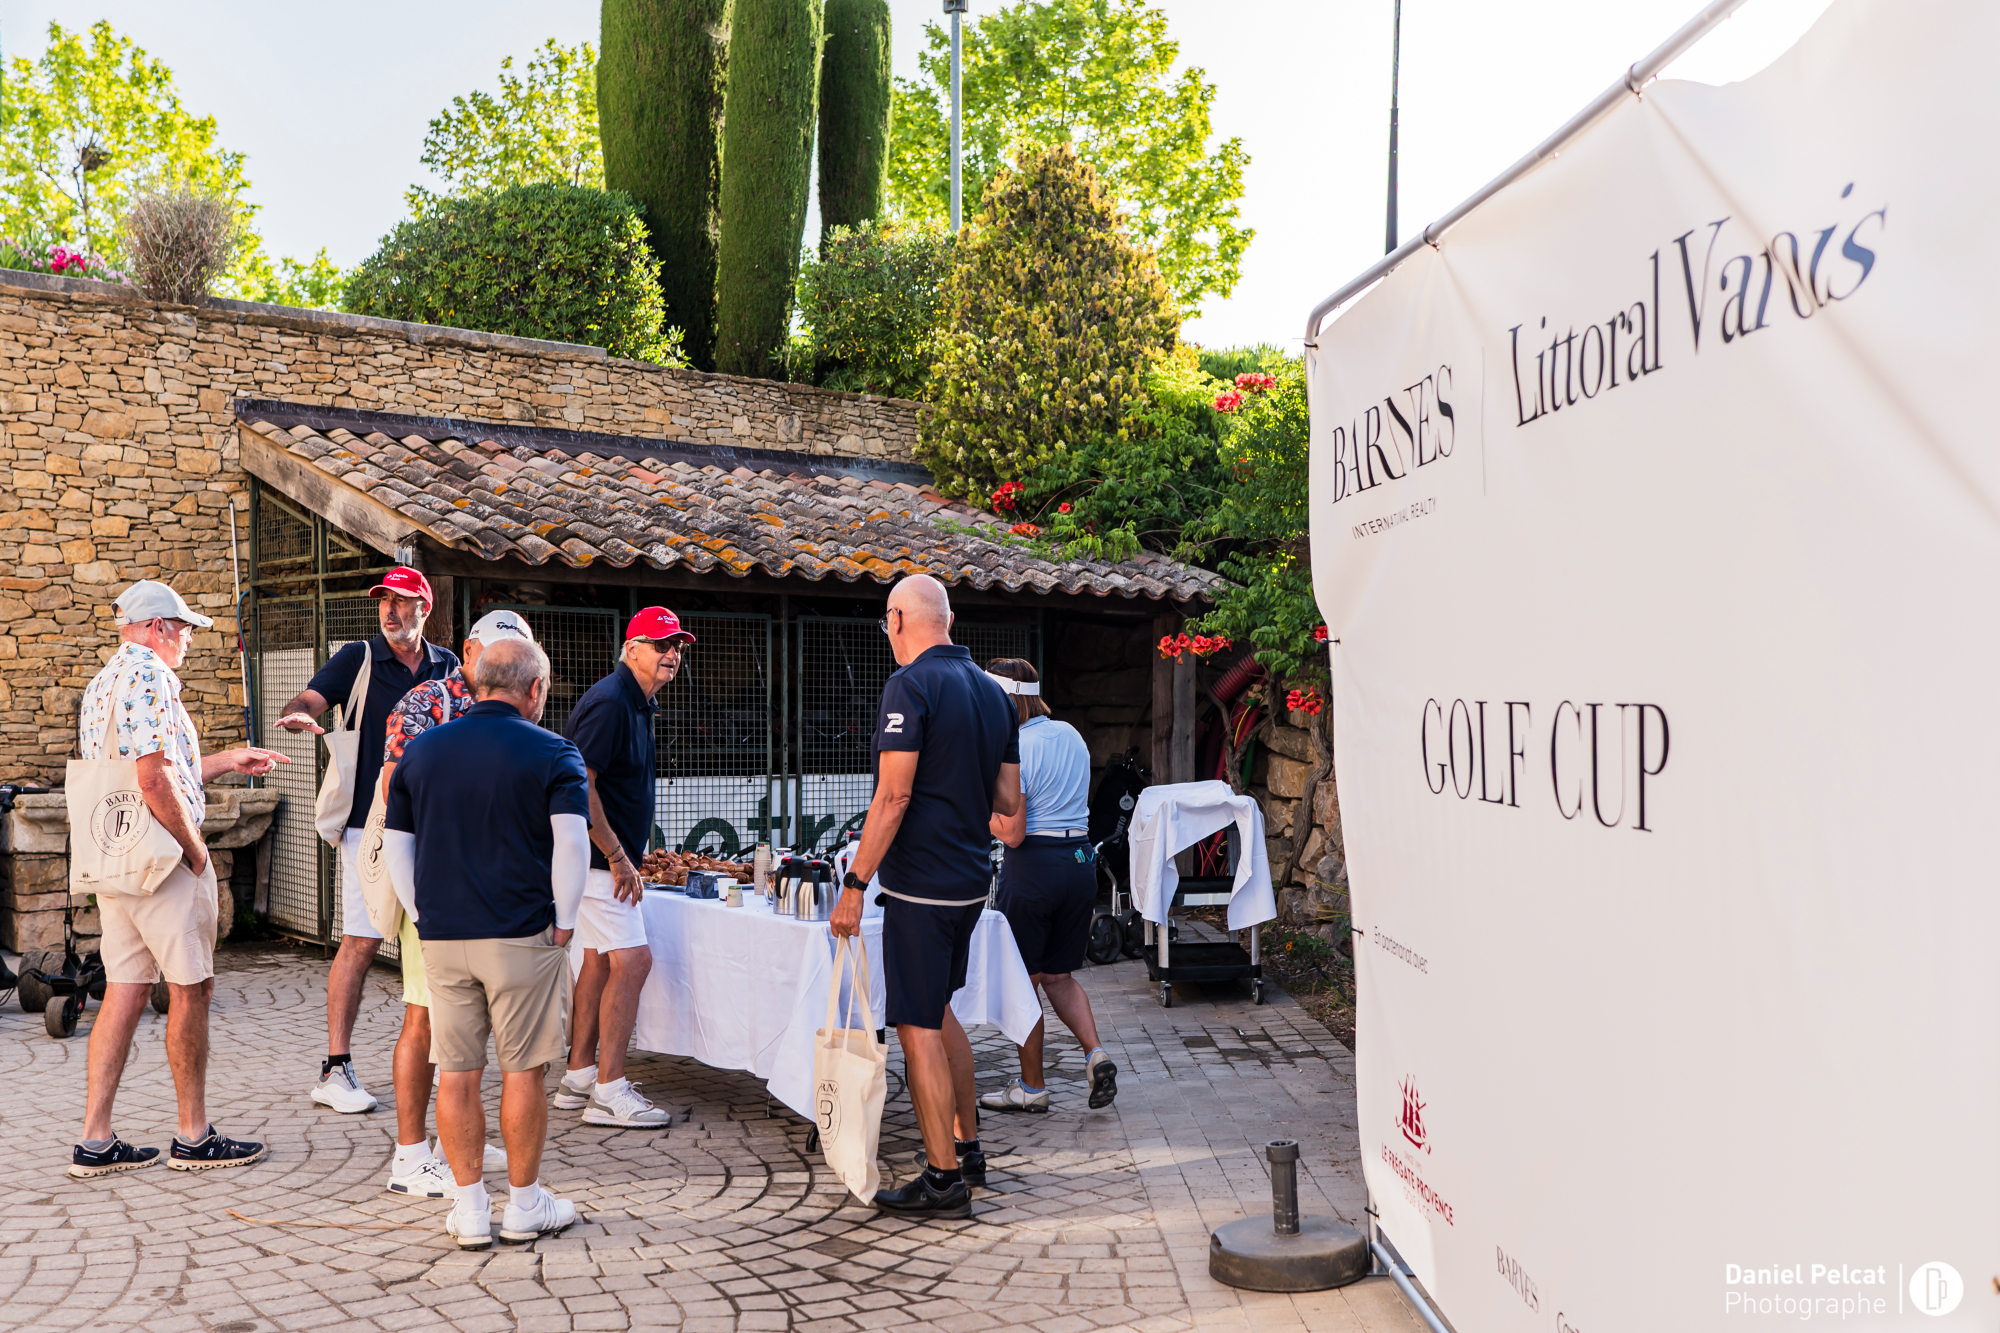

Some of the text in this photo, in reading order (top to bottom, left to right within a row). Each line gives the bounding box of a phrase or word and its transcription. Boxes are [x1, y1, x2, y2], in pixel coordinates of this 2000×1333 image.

[1508, 248, 1663, 428] Littoral
[1332, 364, 1455, 504] BARNES
[1410, 496, 1438, 520] REALTY
[105, 793, 146, 807] BARNS
[1421, 698, 1670, 833] GOLF CUP
[1381, 1142, 1454, 1227] LE FRÉGATE PROVENCE
[1496, 1244, 1539, 1314] BARNES
